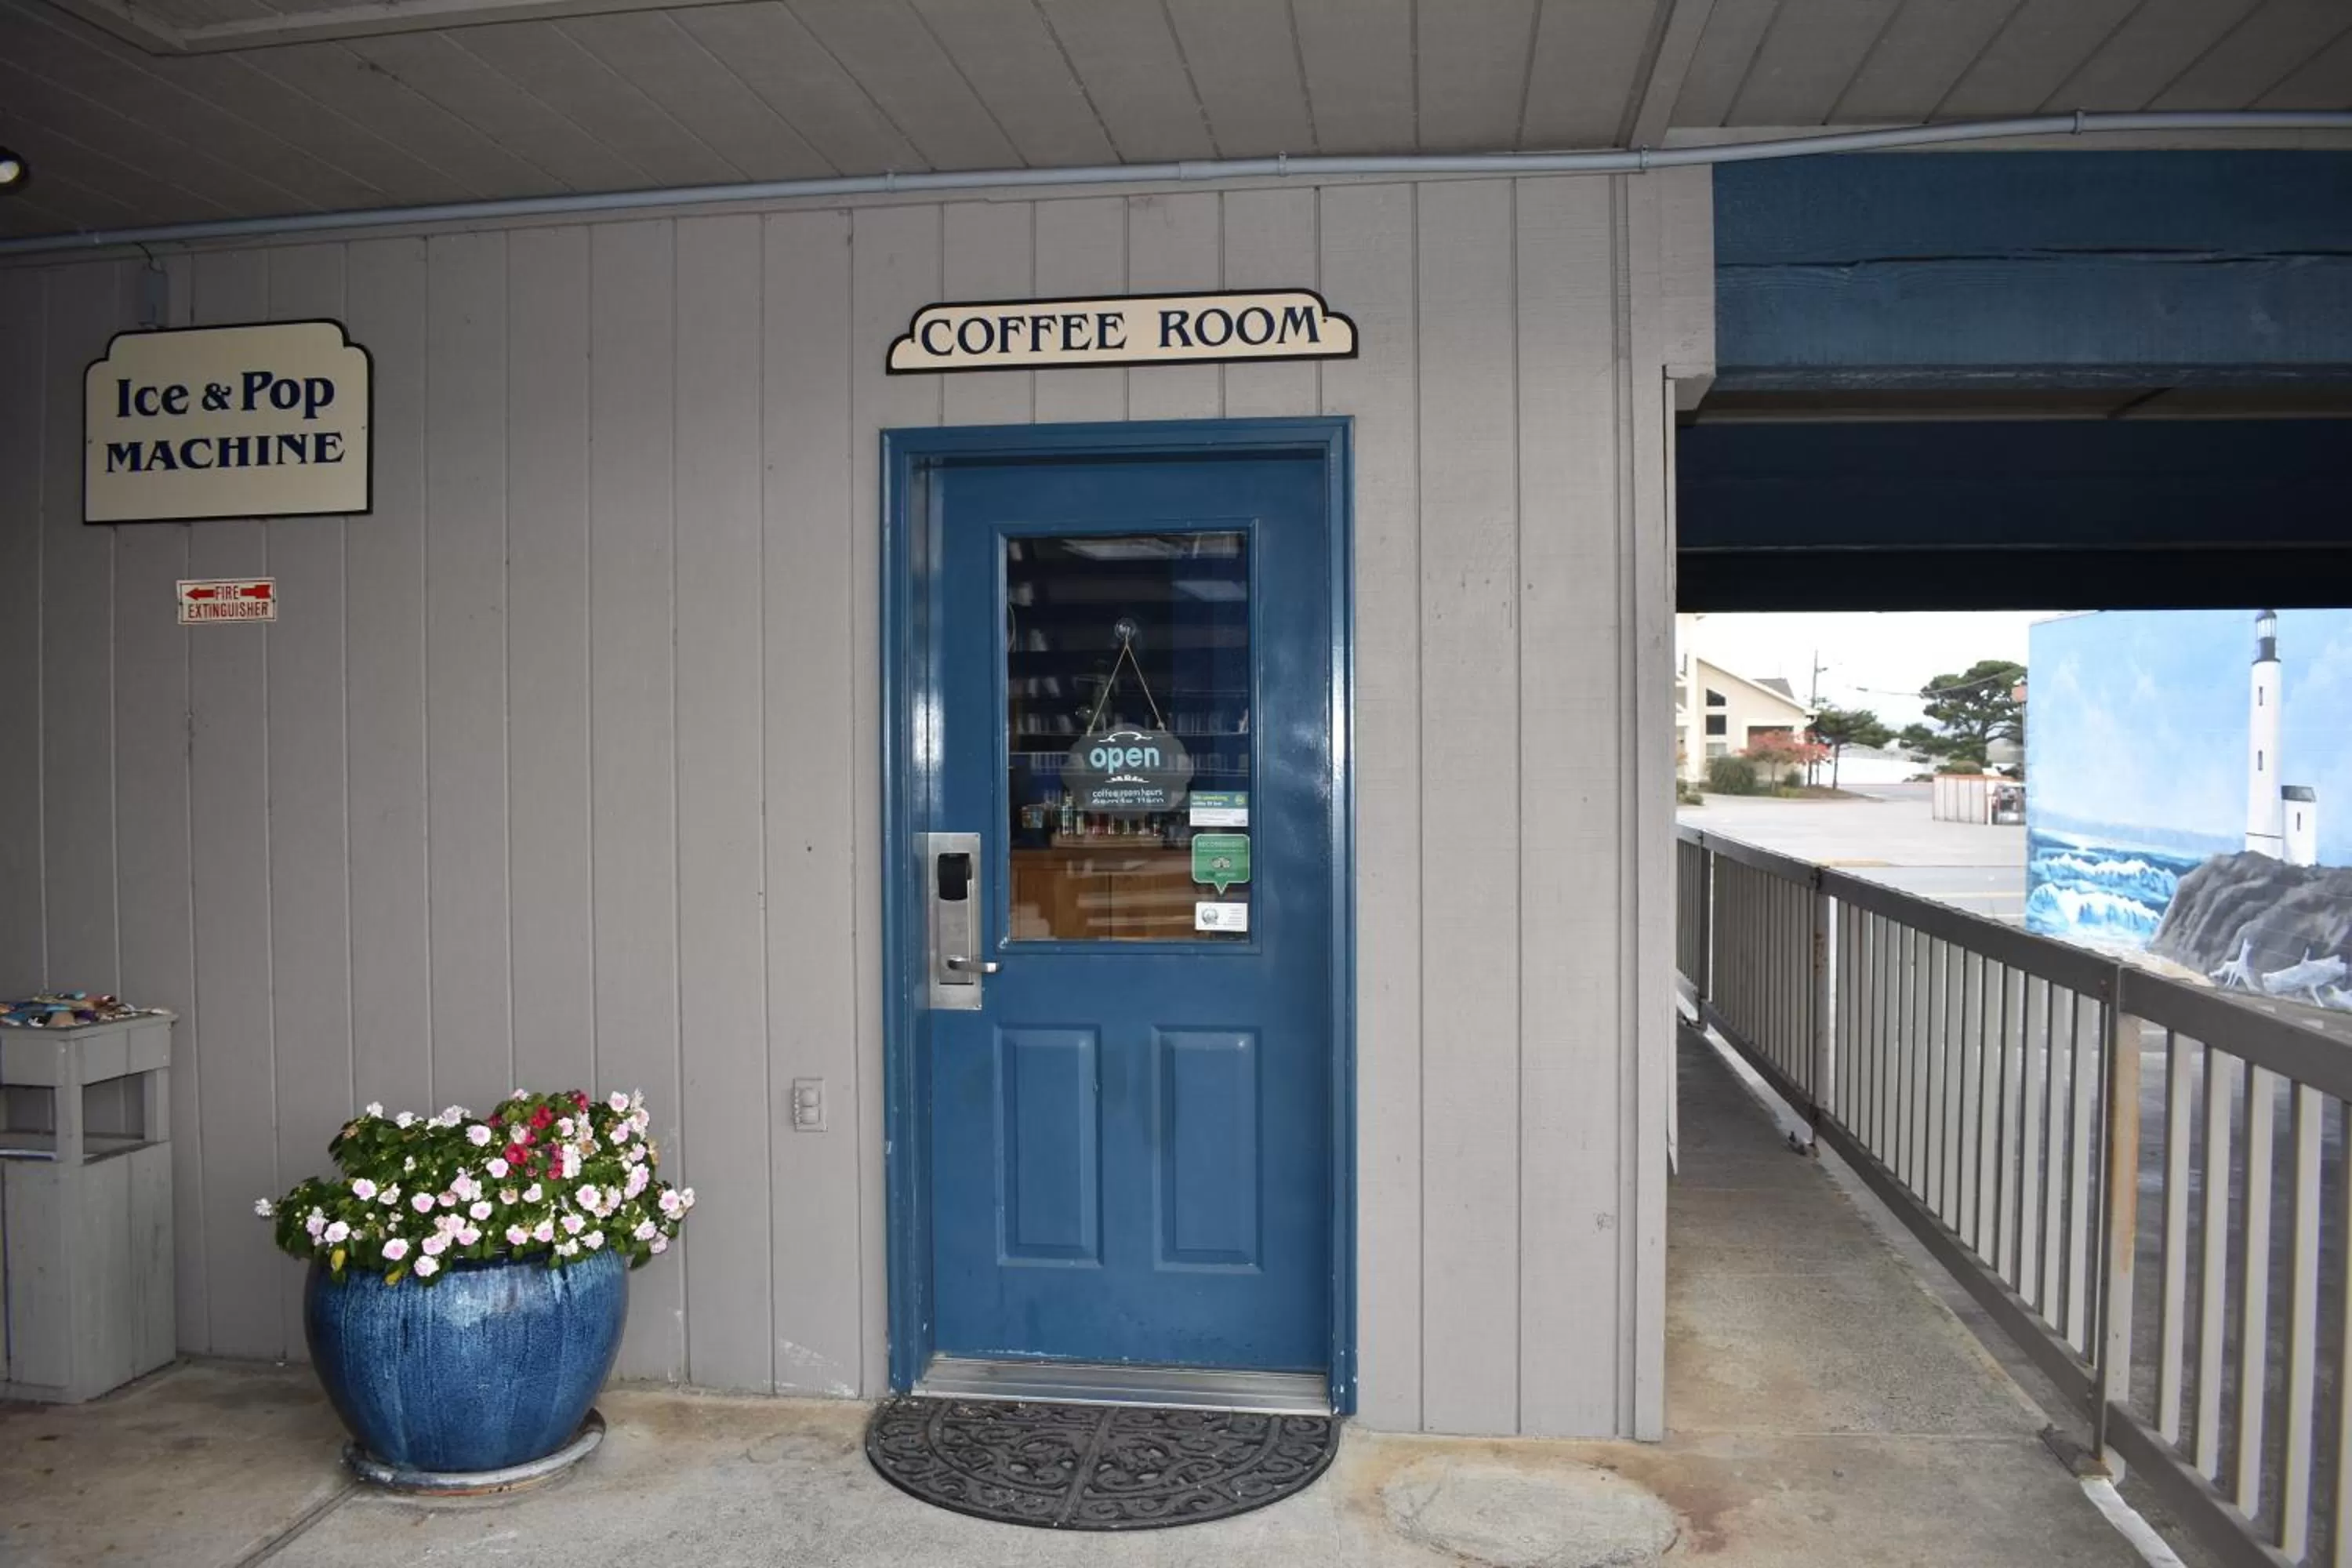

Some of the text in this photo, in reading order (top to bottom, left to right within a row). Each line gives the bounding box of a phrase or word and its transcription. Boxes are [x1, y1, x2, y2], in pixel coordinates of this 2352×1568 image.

[920, 307, 1320, 357] COFFEE ROOM
[116, 371, 335, 419] Ice & Pop
[106, 431, 345, 474] MACHINE
[215, 585, 239, 601] FIRE
[188, 601, 269, 619] EXTINGUISHER
[1090, 747, 1160, 775] open
[1092, 786, 1163, 797] coffee room hours
